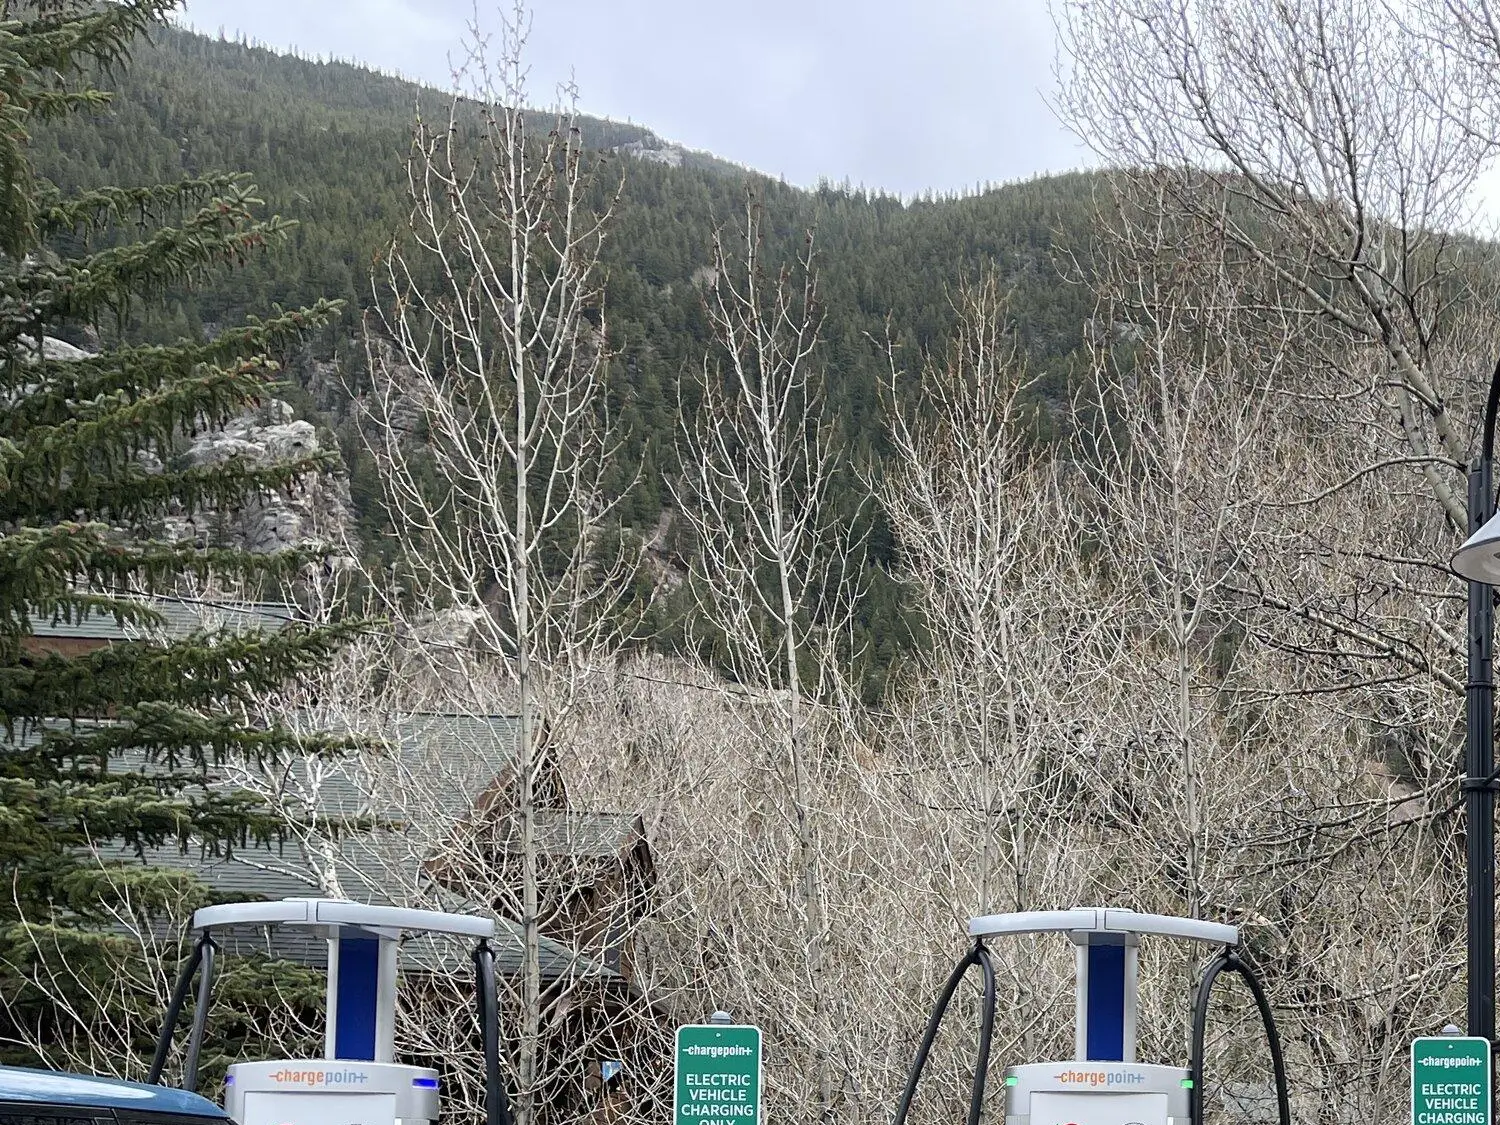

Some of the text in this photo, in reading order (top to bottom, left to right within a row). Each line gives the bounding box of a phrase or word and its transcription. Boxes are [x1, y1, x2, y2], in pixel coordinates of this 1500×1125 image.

[686, 1074, 751, 1086] ELECTRIC
[689, 1089, 747, 1101] VEHICLE
[1421, 1083, 1481, 1095] ELECTRIC
[681, 1104, 754, 1116] CHARGING
[1425, 1098, 1478, 1110] VEHICLE
[1418, 1112, 1485, 1124] CHARGING
